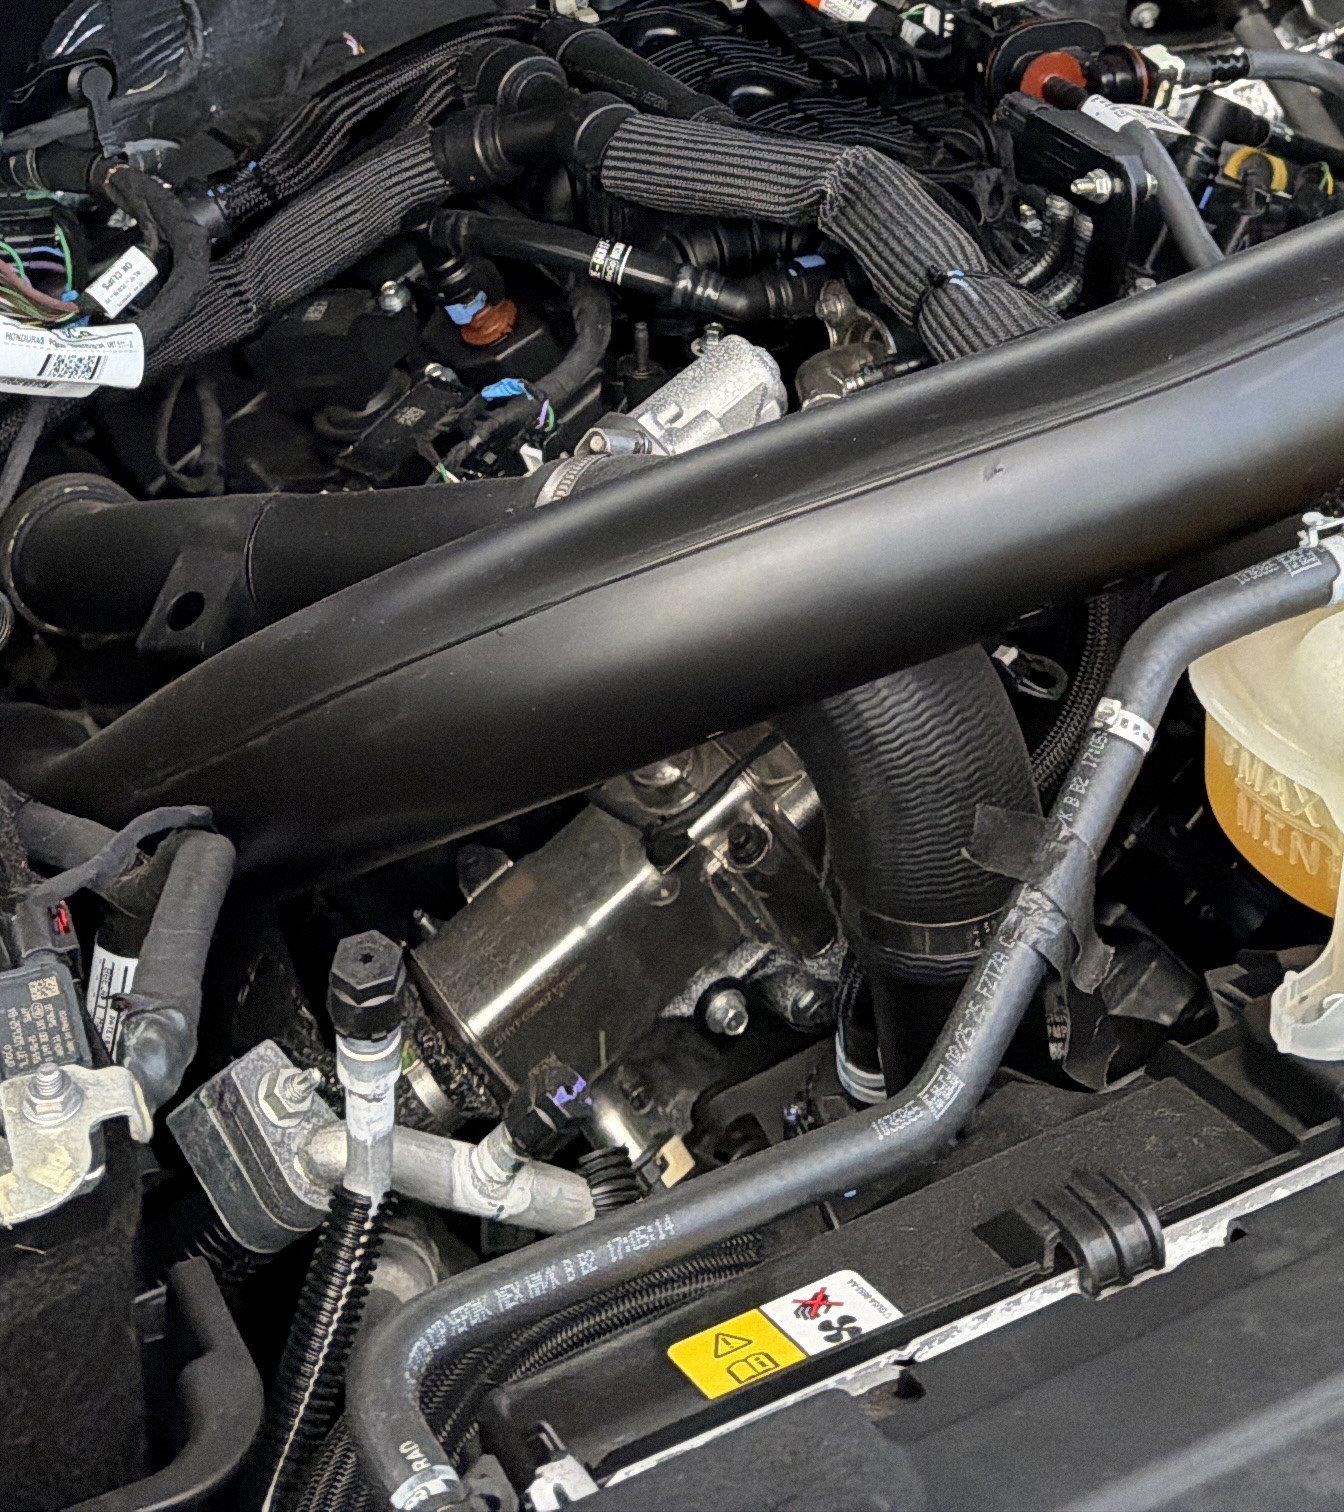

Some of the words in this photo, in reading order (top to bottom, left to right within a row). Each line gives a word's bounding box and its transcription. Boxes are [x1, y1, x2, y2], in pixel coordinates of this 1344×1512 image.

[1238, 749, 1322, 827] MAX
[1236, 792, 1321, 876] MIN
[399, 1439, 431, 1472] RAD
